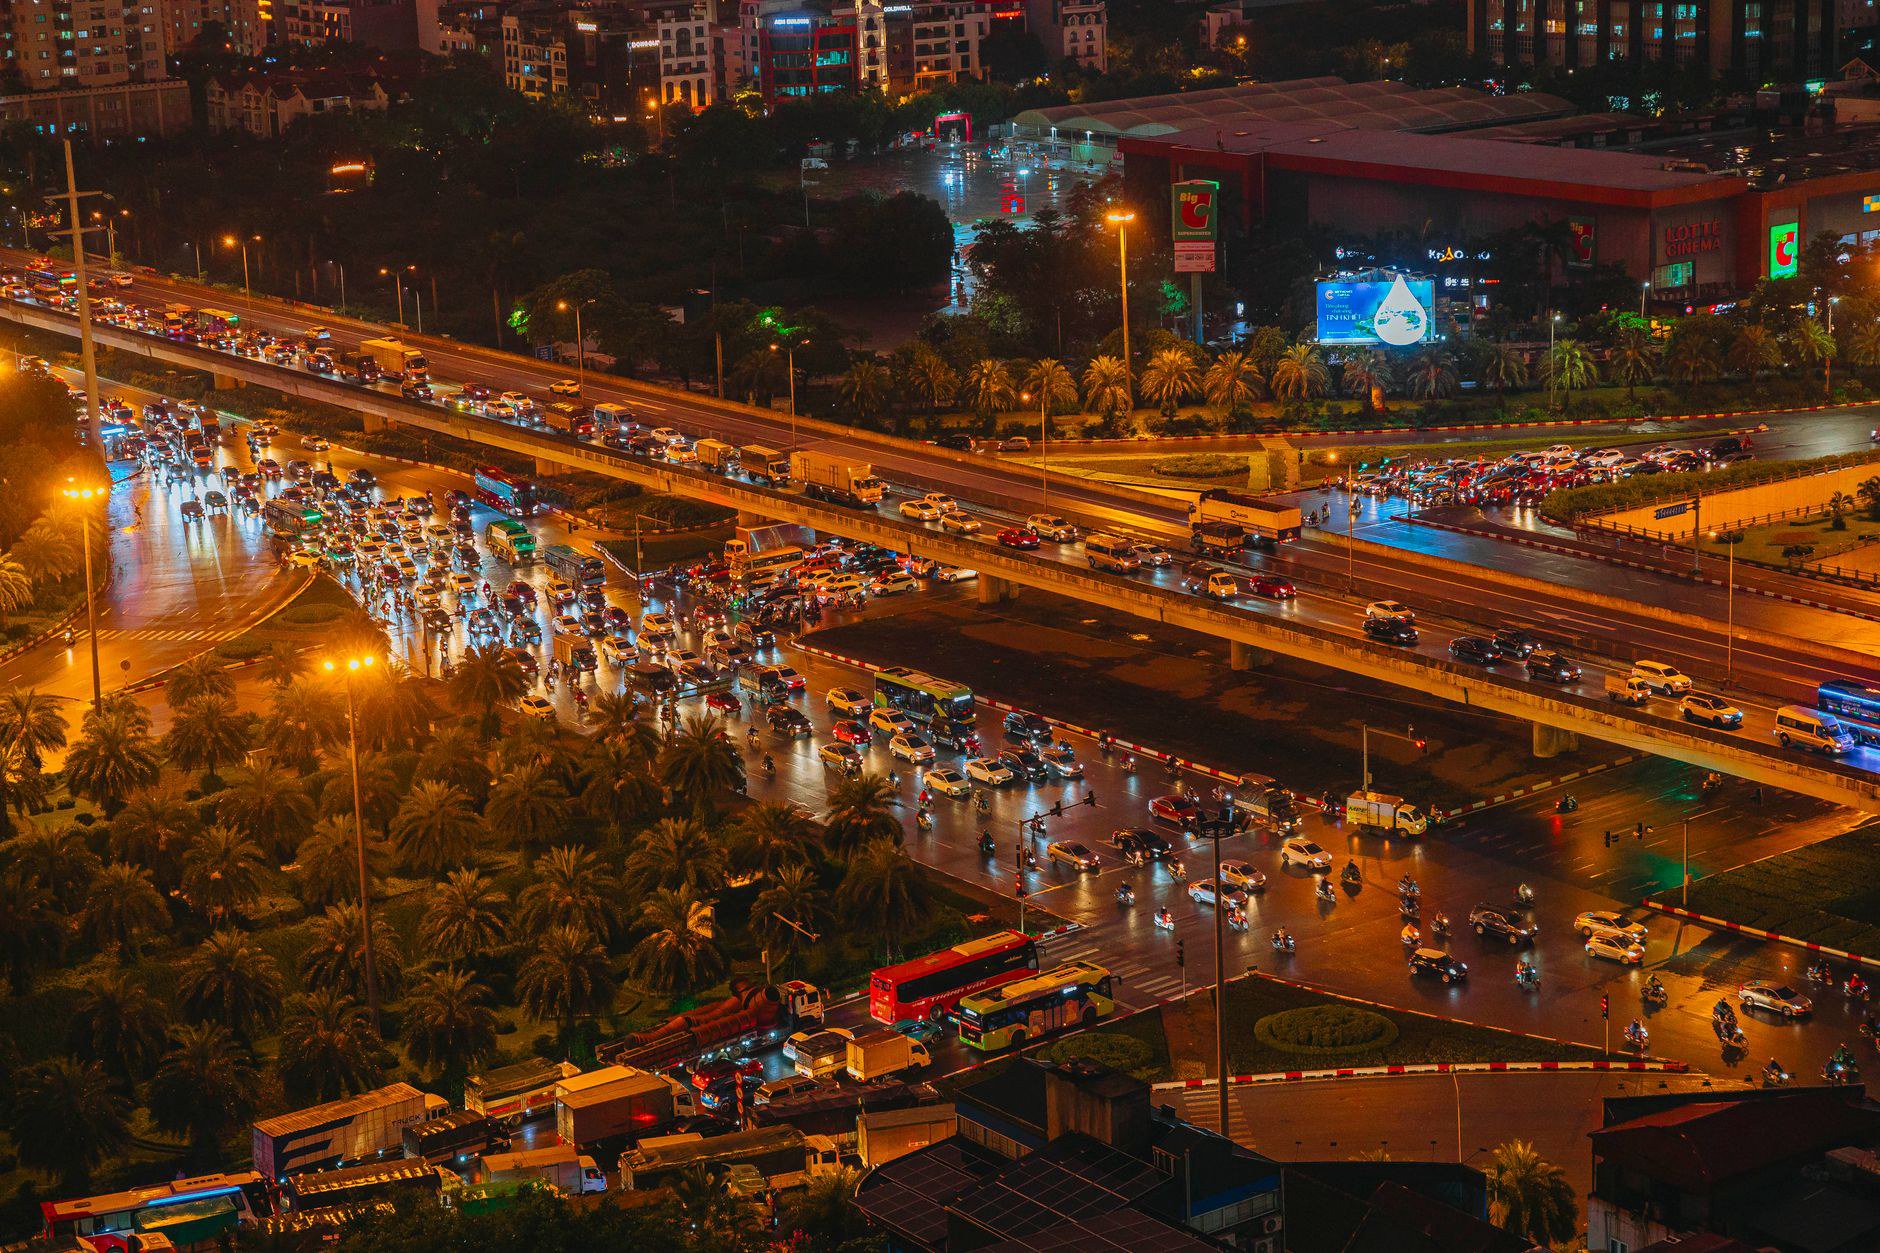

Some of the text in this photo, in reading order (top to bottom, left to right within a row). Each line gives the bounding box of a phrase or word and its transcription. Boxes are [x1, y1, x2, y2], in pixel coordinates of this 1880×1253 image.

[883, 5, 912, 13] GOLDWELL
[1179, 192, 1199, 205] Big
[1181, 192, 1212, 229] C
[1776, 234, 1788, 244] Big
[1665, 239, 1722, 258] CINEMA
[1775, 231, 1796, 267] C
[391, 1113, 421, 1127] TRUCK
